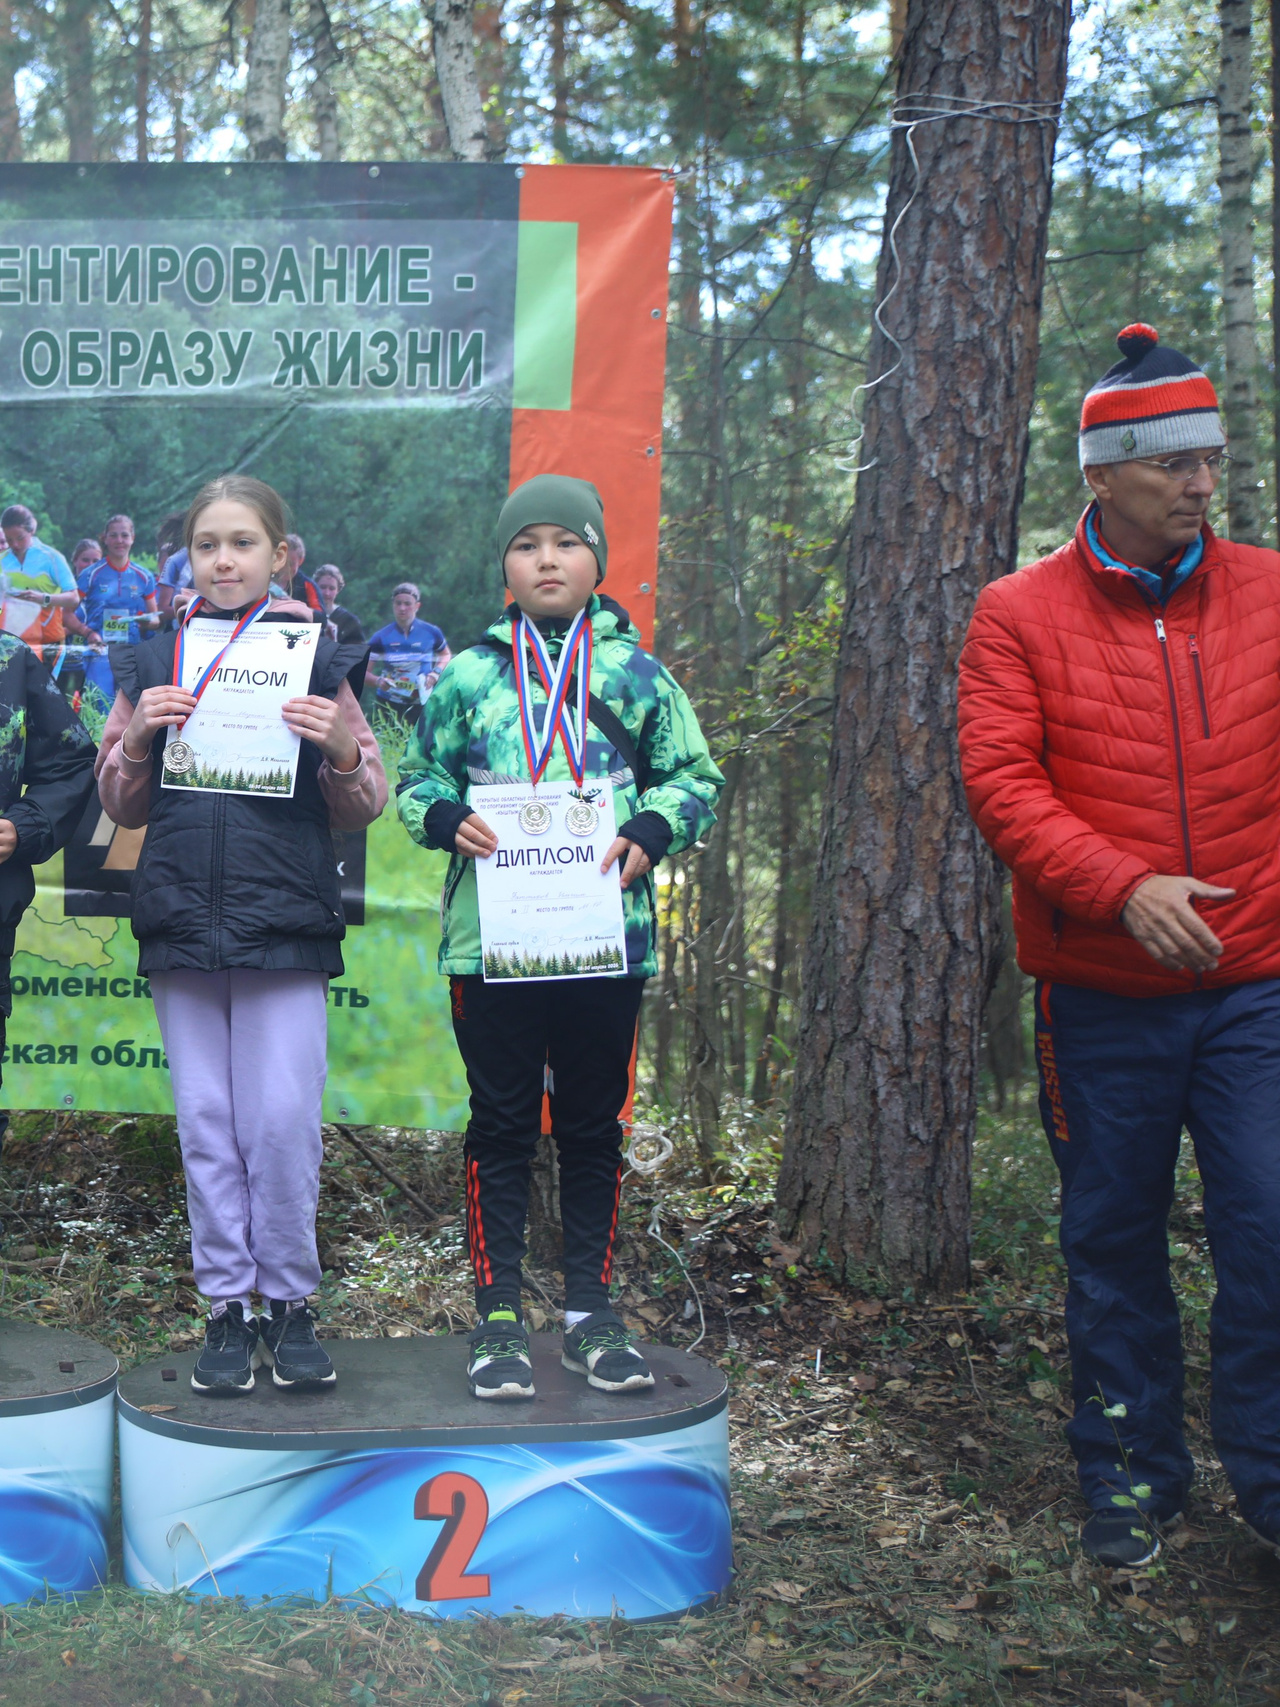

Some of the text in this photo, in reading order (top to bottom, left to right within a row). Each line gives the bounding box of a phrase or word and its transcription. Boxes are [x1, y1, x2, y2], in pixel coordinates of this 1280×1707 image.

[454, 272, 475, 291] -
[22, 330, 253, 388] ОБРАЗУ
[273, 331, 484, 389] ЖИЗНИ
[496, 845, 594, 868] ДИПЛОМ
[1037, 1031, 1070, 1142] RUSSIA
[414, 1471, 491, 1601] 2
